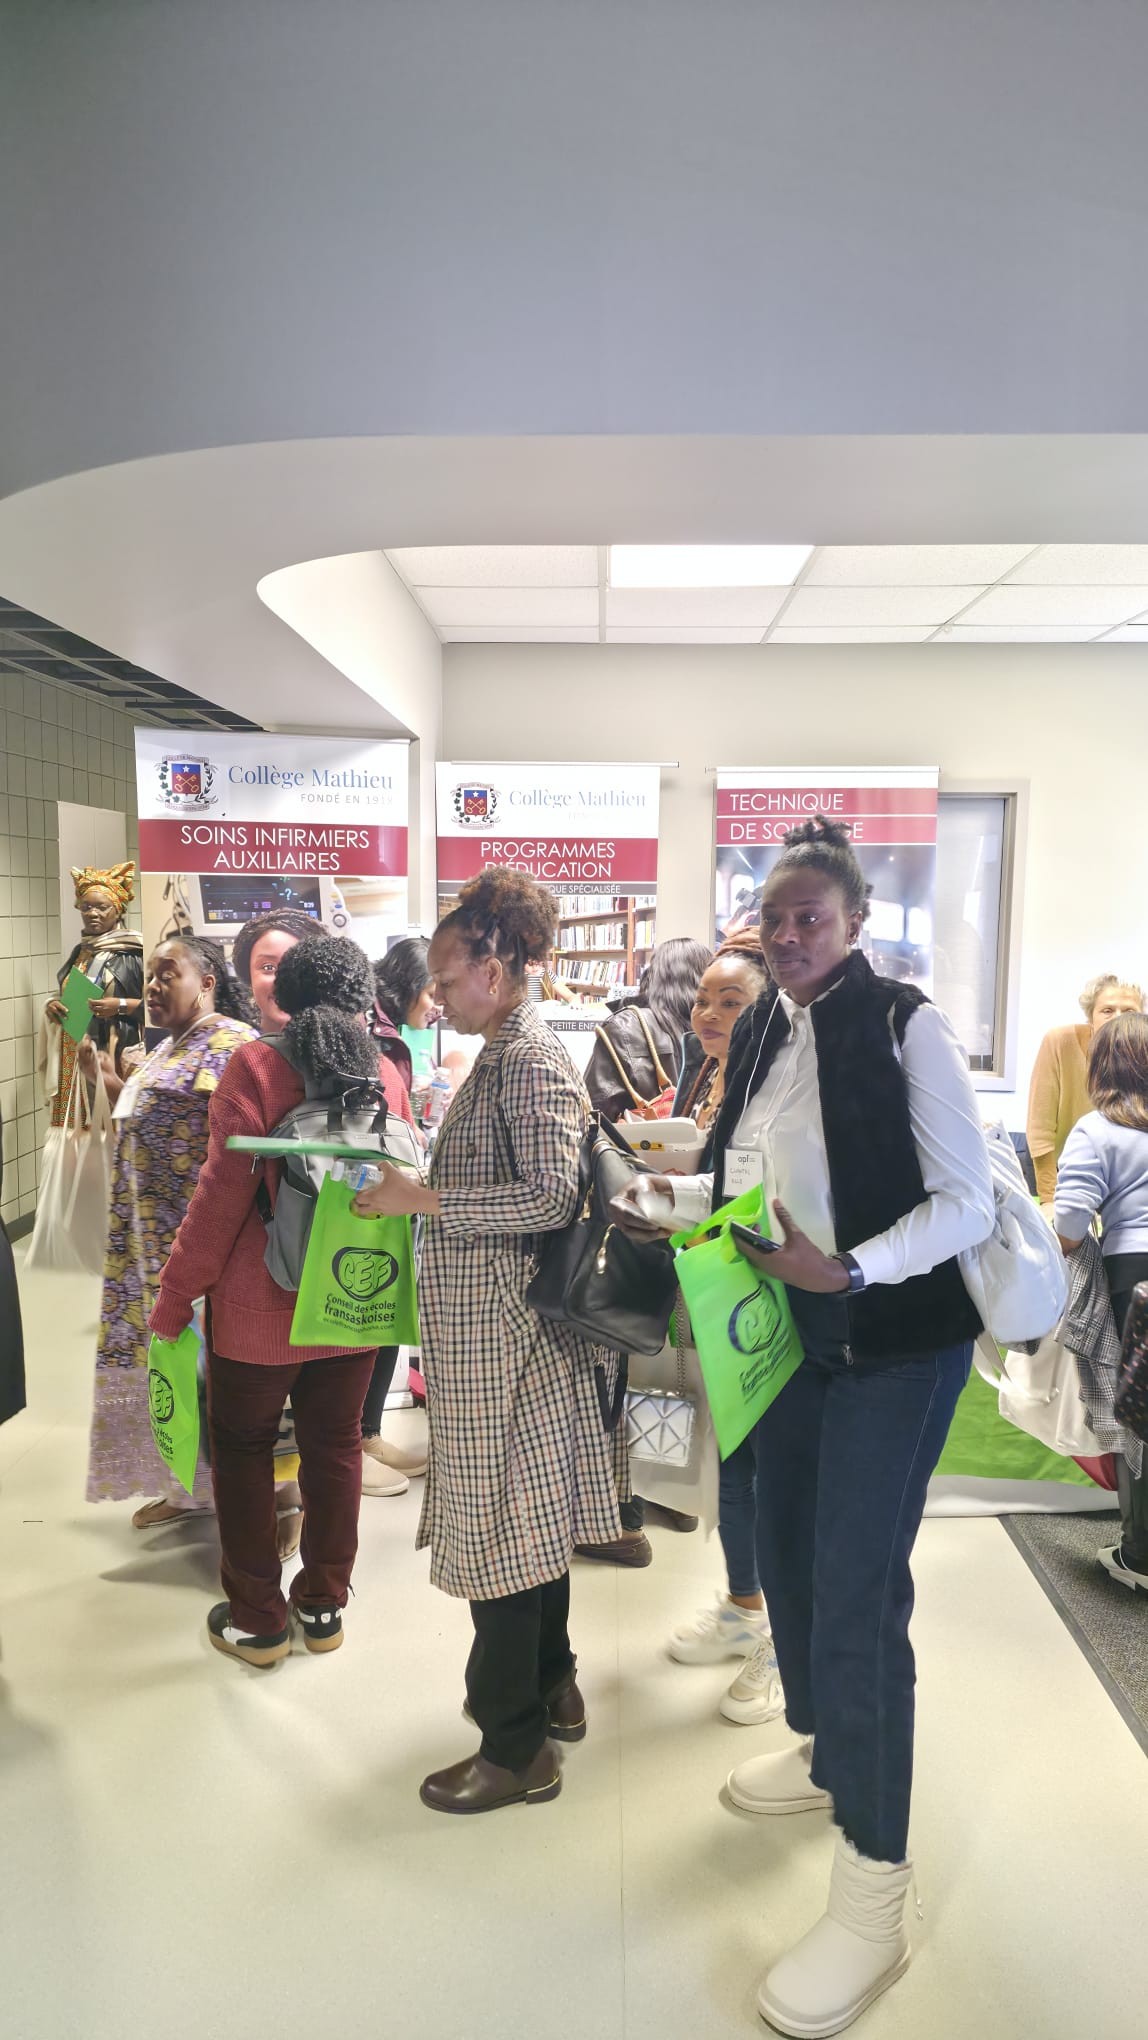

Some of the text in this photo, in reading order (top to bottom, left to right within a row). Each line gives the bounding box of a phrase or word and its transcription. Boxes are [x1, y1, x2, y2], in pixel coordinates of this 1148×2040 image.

[228, 765, 393, 790] Collège Mathieu
[300, 792, 340, 804] FONDÉ
[345, 795, 360, 805] EN
[509, 788, 572, 809] Collège
[729, 793, 844, 812] TECHNIQUE
[180, 825, 370, 849] SOINS INFIRMIERS
[730, 822, 757, 841] DE
[480, 841, 615, 859] PROGRAMMES
[213, 850, 340, 872] AUXILIAIRES
[568, 883, 621, 894] SPÉCIALISÉE
[551, 1021, 577, 1031] PETITE
[326, 1291, 354, 1310] Conseil
[354, 1303, 369, 1314] des
[324, 1302, 396, 1325] fransaskoises
